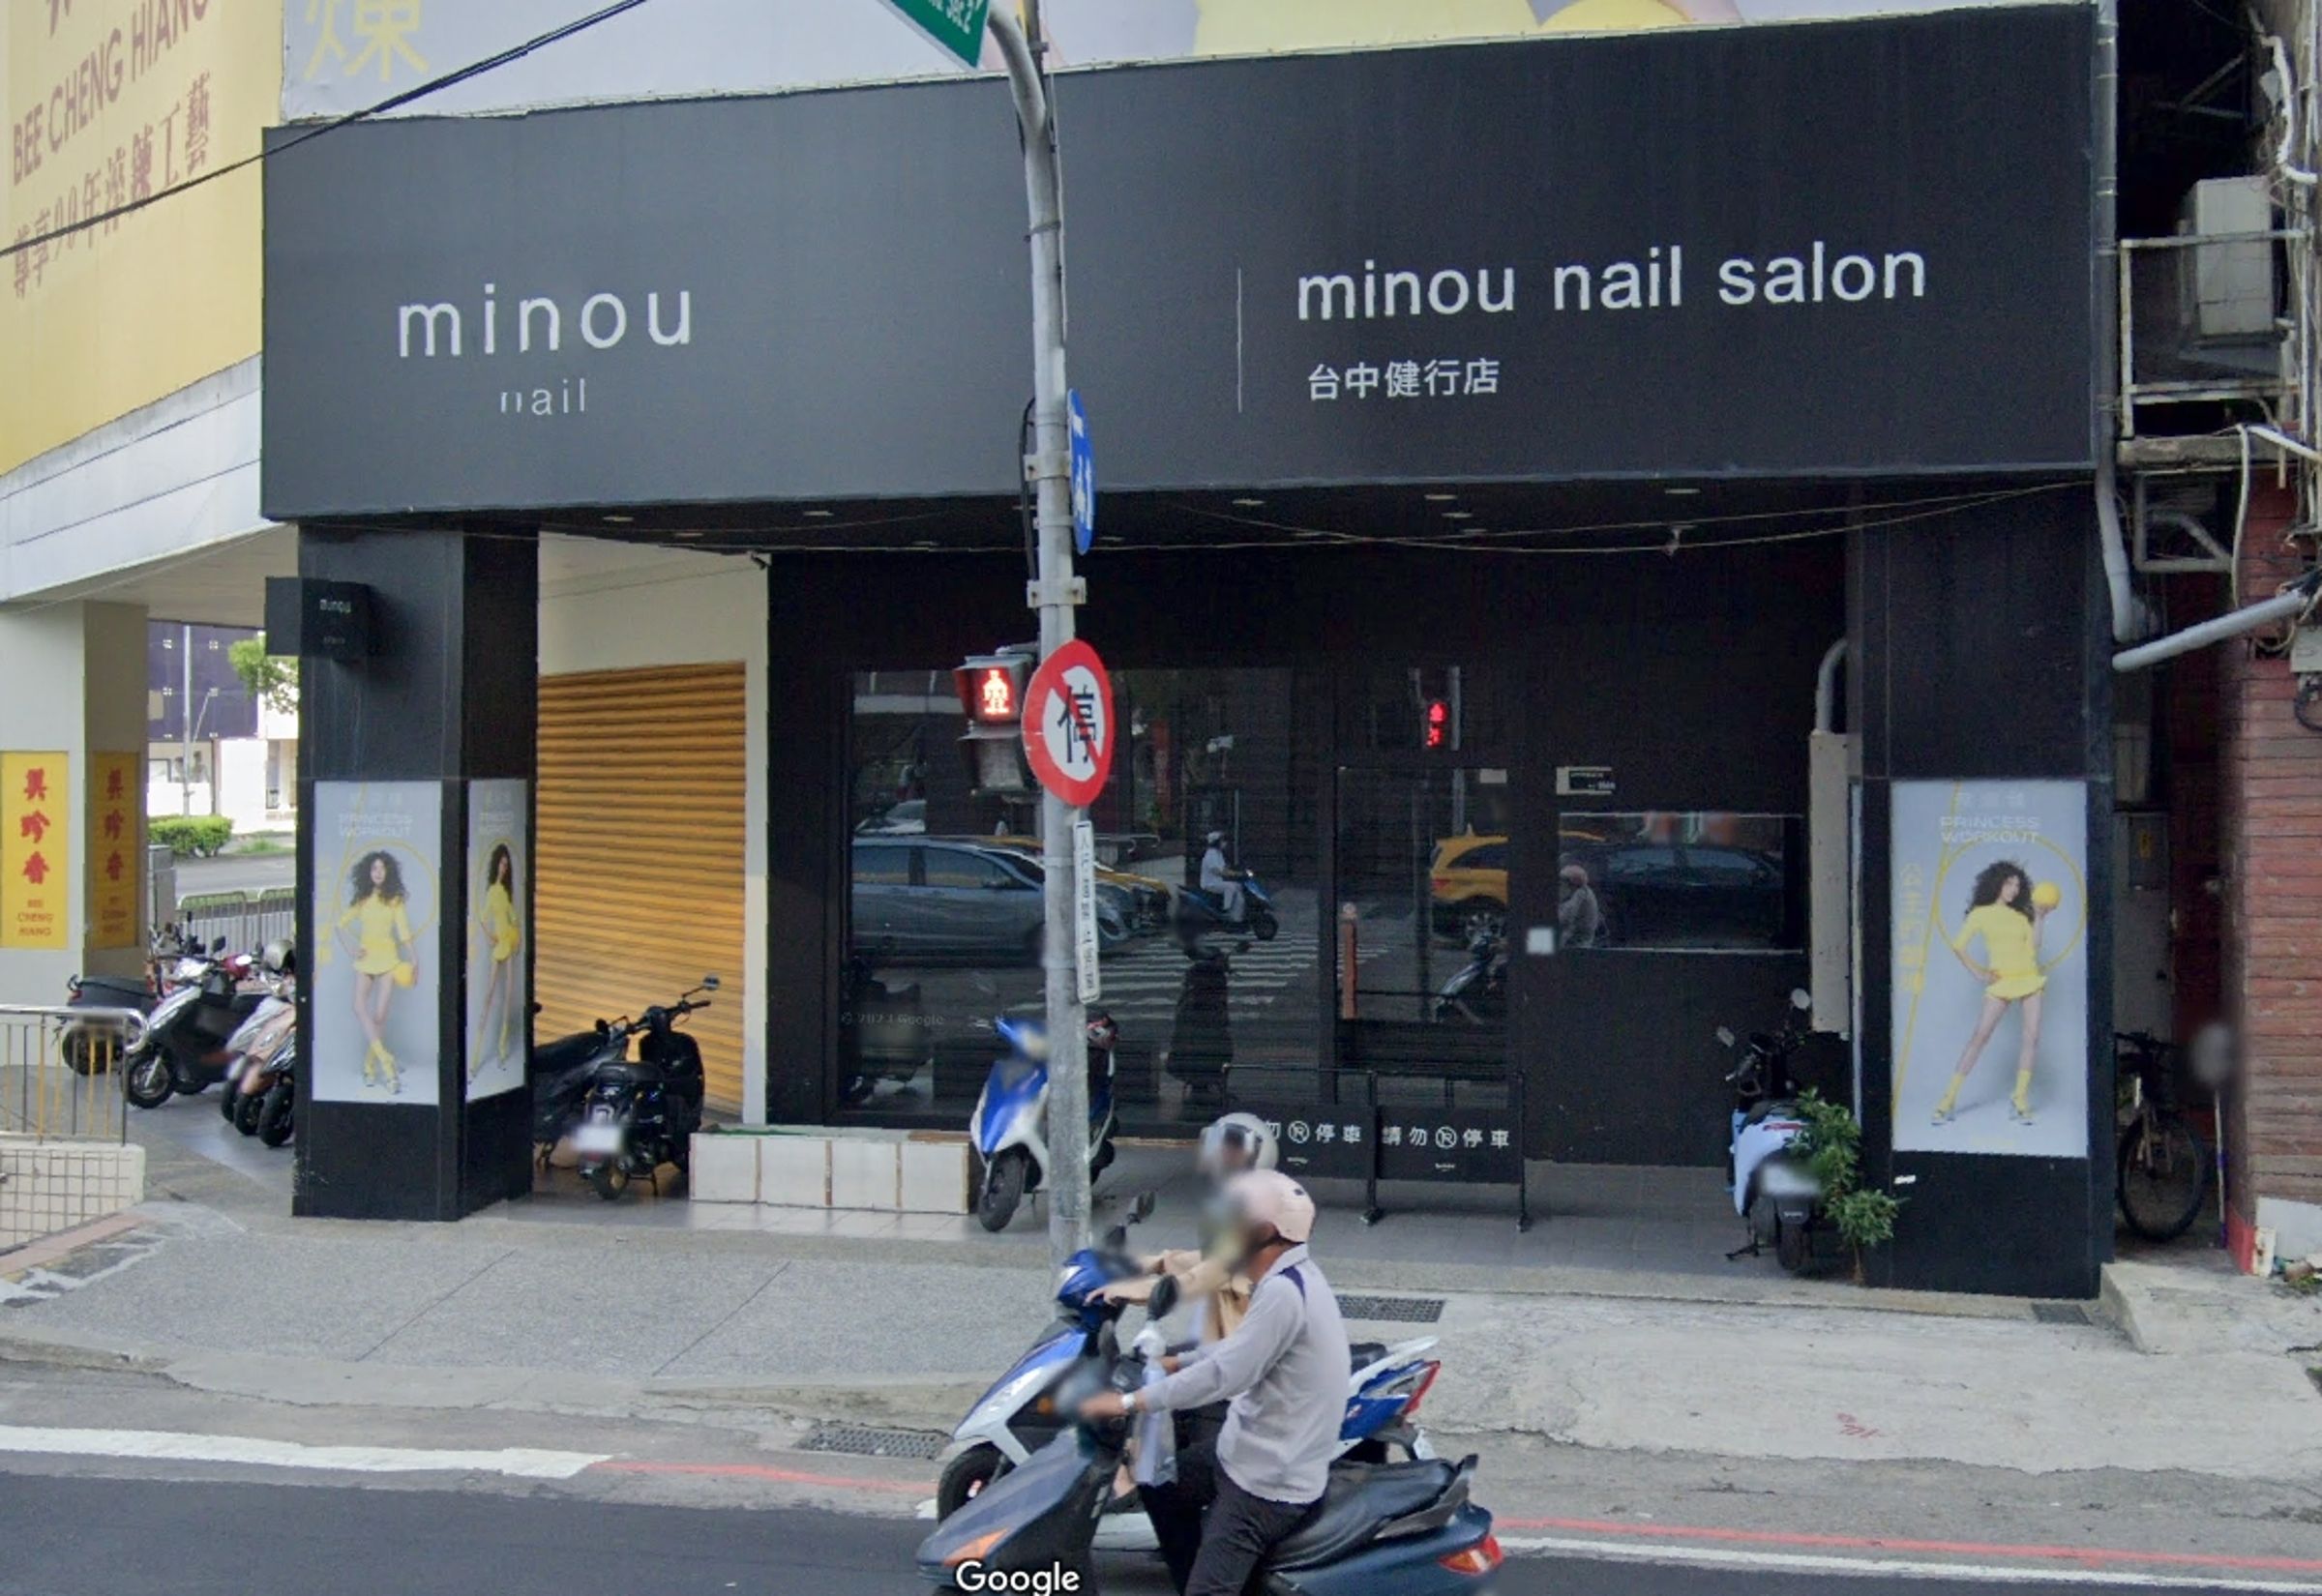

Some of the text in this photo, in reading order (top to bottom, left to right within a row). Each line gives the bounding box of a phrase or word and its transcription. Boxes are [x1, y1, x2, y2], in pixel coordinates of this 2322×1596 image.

[13, 103, 44, 187] BEE
[48, 27, 123, 155] CHENG
[1297, 241, 1926, 320] minou nail salon
[399, 283, 690, 358] minou
[500, 377, 585, 416] nail
[1307, 358, 1501, 400] 台中健行店
[1940, 814, 2042, 829] PRINCESS
[1941, 830, 2040, 844] WORKOUT
